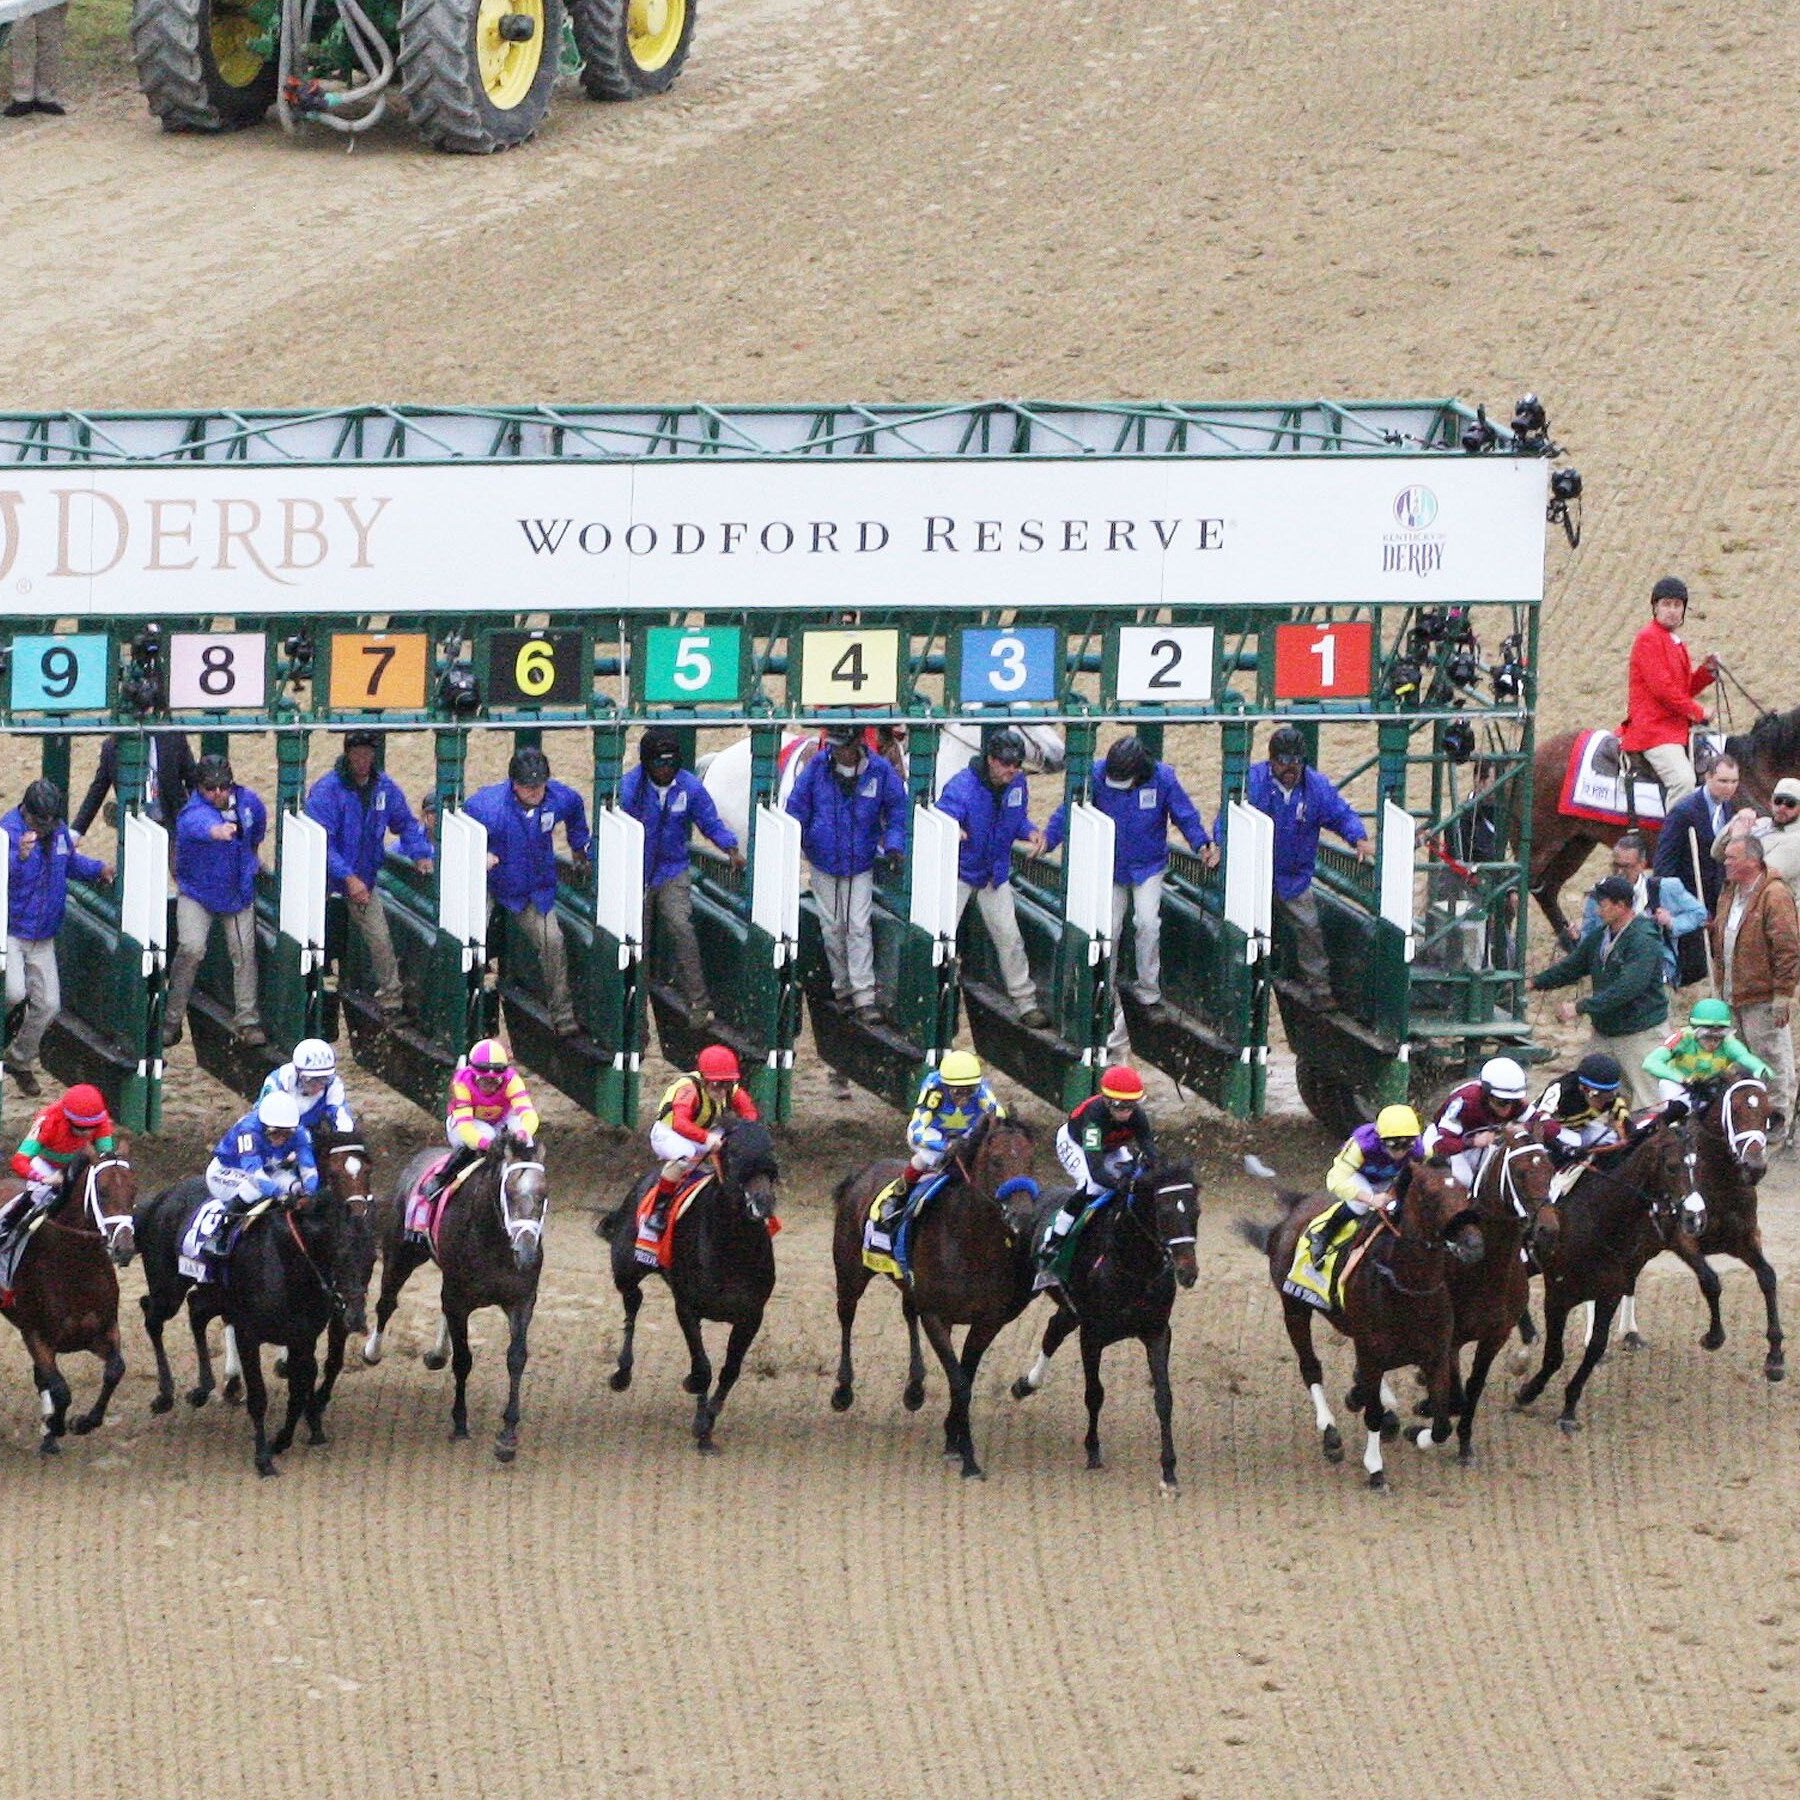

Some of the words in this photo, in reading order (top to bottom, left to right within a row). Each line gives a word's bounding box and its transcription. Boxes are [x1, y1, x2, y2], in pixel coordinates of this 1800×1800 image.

[46, 488, 393, 586] DERBY
[517, 517, 890, 556] WOODFORD
[923, 516, 1225, 553] RESERVE
[1382, 542, 1446, 579] DERBY
[40, 645, 79, 699] 9
[198, 644, 236, 696] 8
[361, 646, 396, 696] 7
[515, 640, 555, 696] 6
[673, 636, 712, 691] 5
[830, 642, 869, 692] 4
[988, 637, 1027, 692] 3
[1147, 638, 1183, 689] 2
[1310, 634, 1336, 687] 1
[927, 1091, 943, 1109] 6
[237, 1134, 254, 1154] 10
[1085, 1128, 1099, 1147] 5
